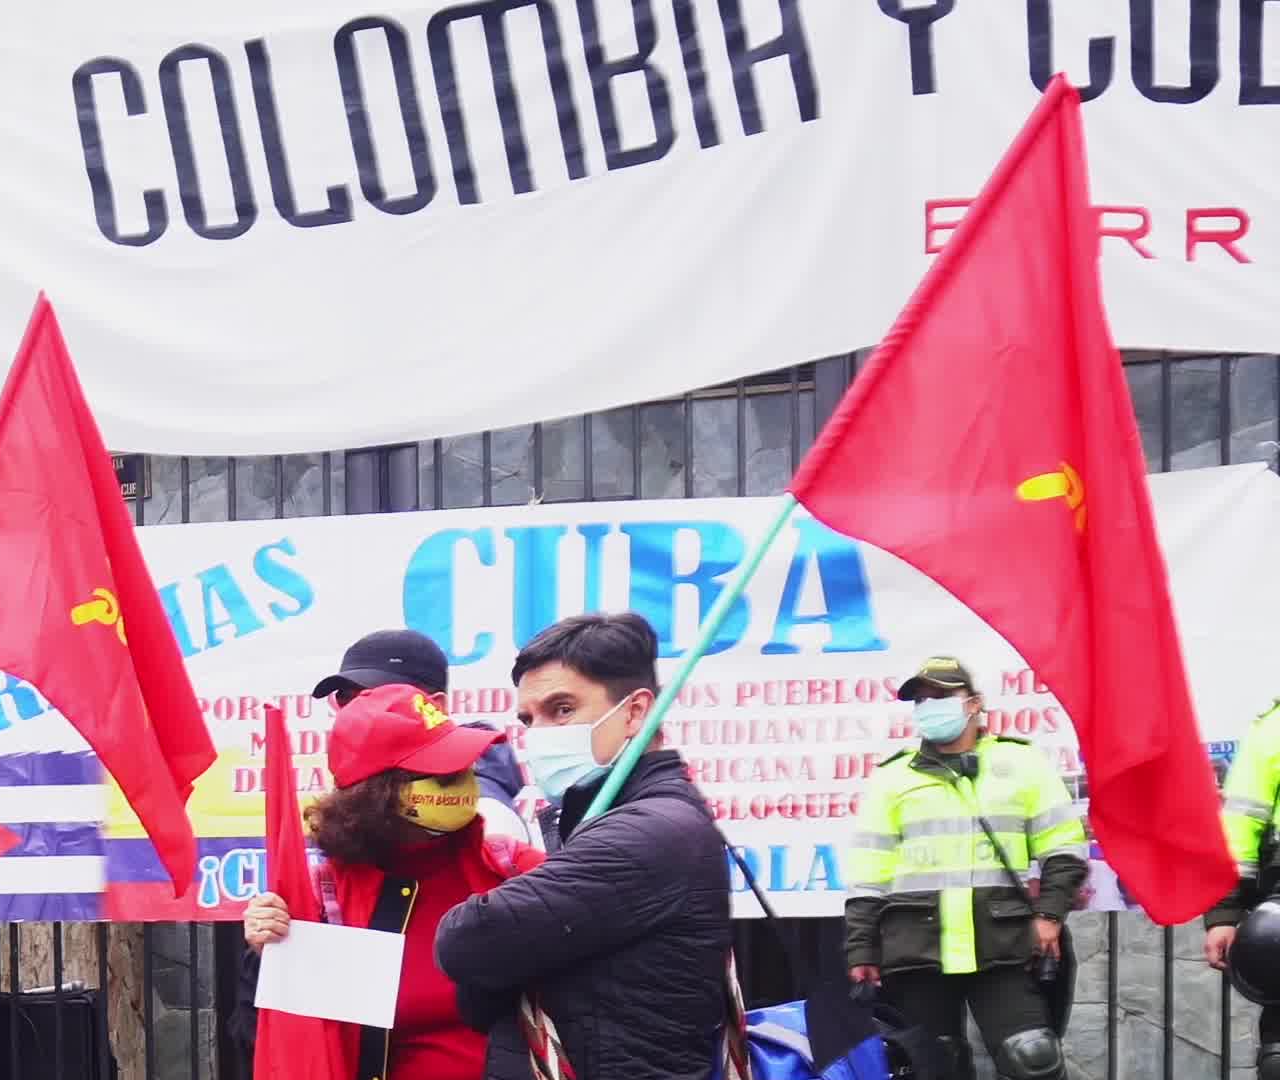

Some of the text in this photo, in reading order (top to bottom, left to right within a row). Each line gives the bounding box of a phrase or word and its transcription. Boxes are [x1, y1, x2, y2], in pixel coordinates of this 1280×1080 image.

[72, 0, 821, 247] COLOMBIA
[403, 520, 889, 666] CUBA
[661, 713, 873, 747] STUDIANTES
[736, 674, 898, 707] PUEBLOS
